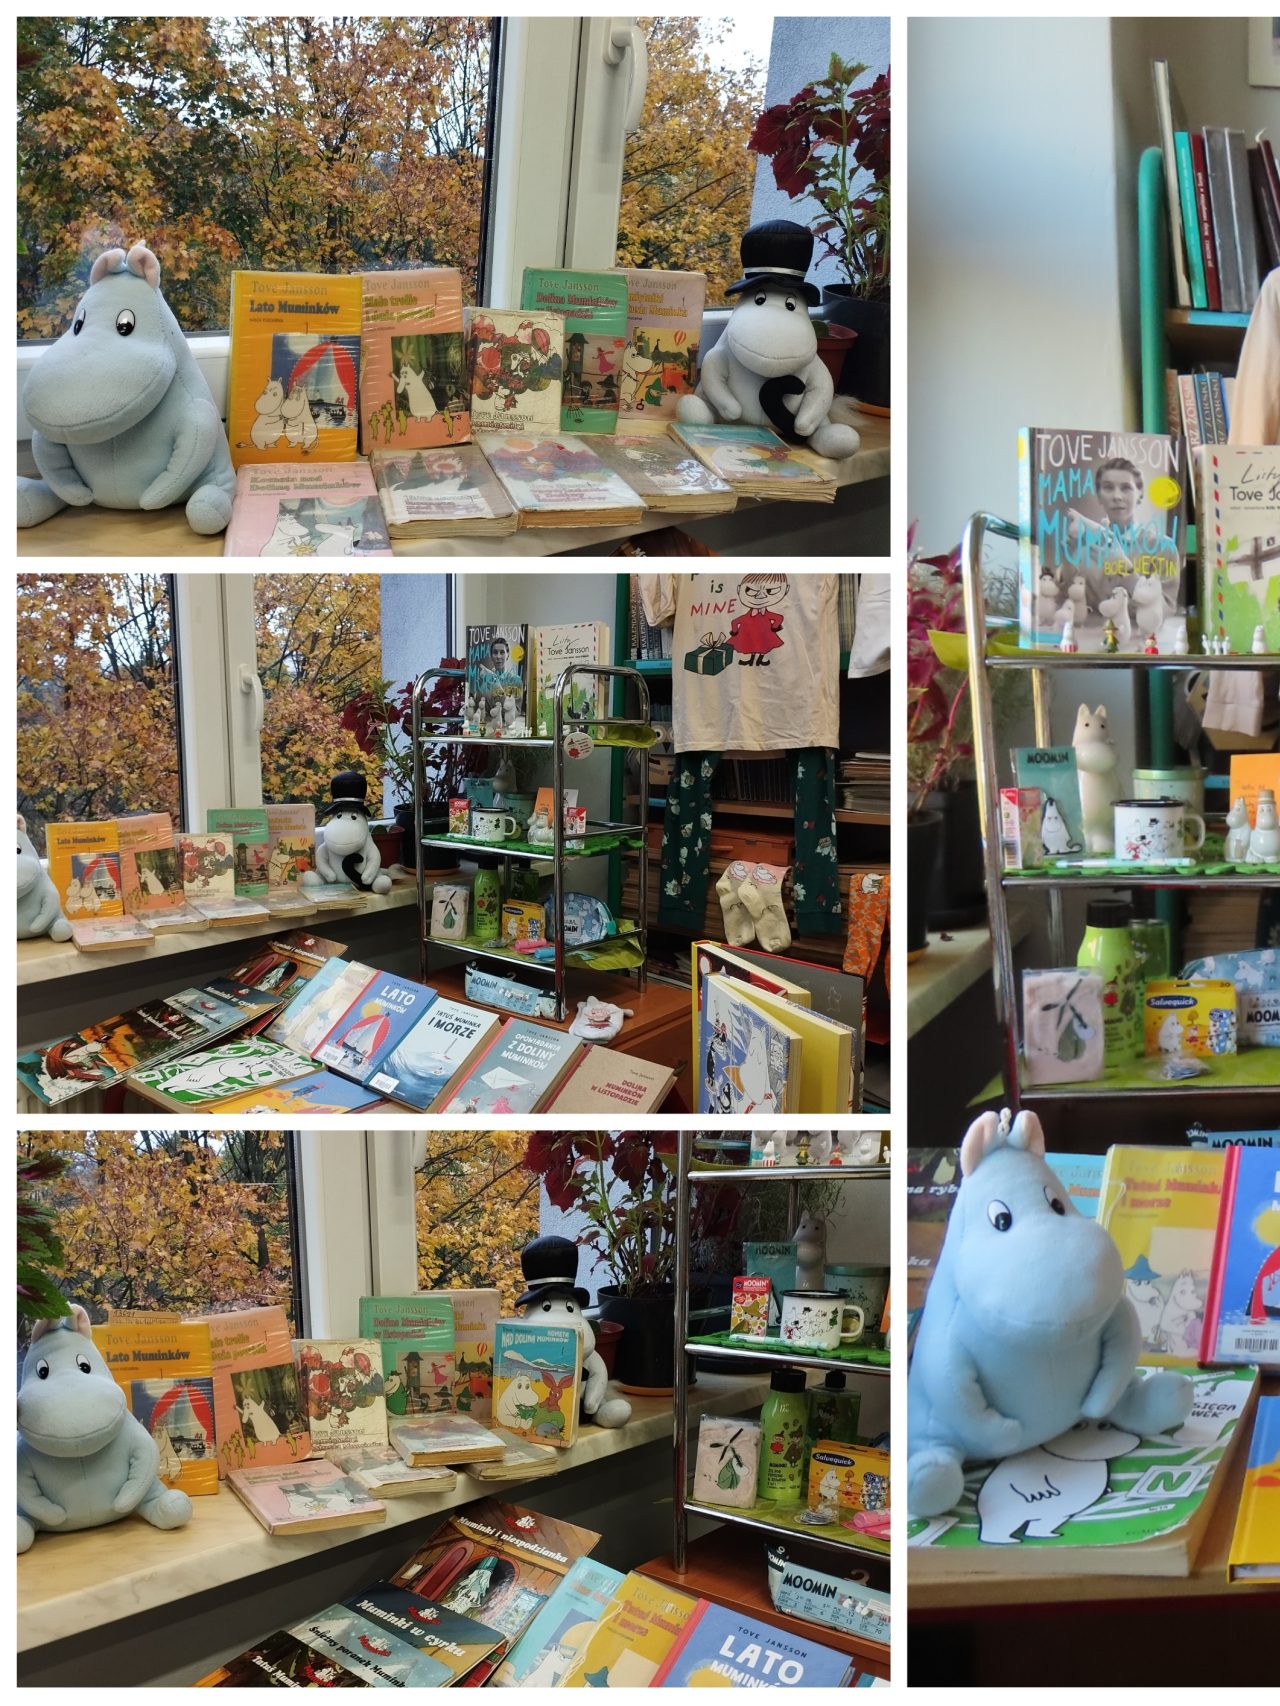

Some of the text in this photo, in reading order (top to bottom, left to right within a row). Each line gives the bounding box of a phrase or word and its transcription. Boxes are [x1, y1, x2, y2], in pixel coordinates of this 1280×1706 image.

[252, 281, 328, 296] Tove Jansson
[364, 278, 430, 292] Tove Jansson
[539, 278, 600, 292] Tove Jansson
[642, 278, 677, 291] Jansson
[250, 300, 340, 315] Lato Muminków
[1036, 433, 1180, 473] TOVE JANSSON
[1038, 467, 1095, 506] MAMA
[1230, 486, 1263, 502] Tove
[1104, 554, 1177, 577] BOEL WESTIN
[711, 580, 723, 593] is
[691, 598, 737, 616] MINE
[469, 626, 525, 646] TOVE JANSSON
[469, 644, 491, 660] MAMA
[547, 644, 590, 656] Tove Jansson
[1026, 751, 1070, 765] MOOMIN
[471, 975, 498, 990] MOOMIN
[380, 985, 416, 1006] LATO
[1149, 998, 1195, 1008] Salvequick
[375, 997, 408, 1014] MUMINKÓW
[435, 1010, 482, 1028] TATUŚ MUMINKA
[428, 1017, 477, 1039] I MORZE
[515, 1033, 561, 1051] OPOWIADANIA
[508, 1040, 556, 1061] Z DOLINY
[500, 1051, 549, 1071] MUMINKÓW
[606, 1082, 644, 1099] MUMINKÓW
[622, 1079, 647, 1092] DOLINA
[597, 1087, 640, 1106] LISTOPADZIE
[744, 1279, 768, 1287] MOOMIN
[375, 1304, 428, 1314] Tove Jansson
[224, 1318, 259, 1331] Jansson
[106, 1333, 177, 1345] Tove Jansson
[224, 1333, 250, 1347] trolle
[502, 1334, 513, 1347] NAD
[106, 1350, 190, 1362] Lato Muminków
[815, 1454, 852, 1465] Salvequick
[457, 1516, 495, 1537] Muminki
[500, 1533, 569, 1564] niespodzianka
[783, 1573, 838, 1599] MOOMIN
[656, 1600, 689, 1619] Jansso
[356, 1599, 467, 1658] Muminki w cyrku
[308, 1625, 371, 1668] Śnieżny poranek
[738, 1626, 808, 1658] TOVE JANSSON
[719, 1635, 804, 1684] LATO
